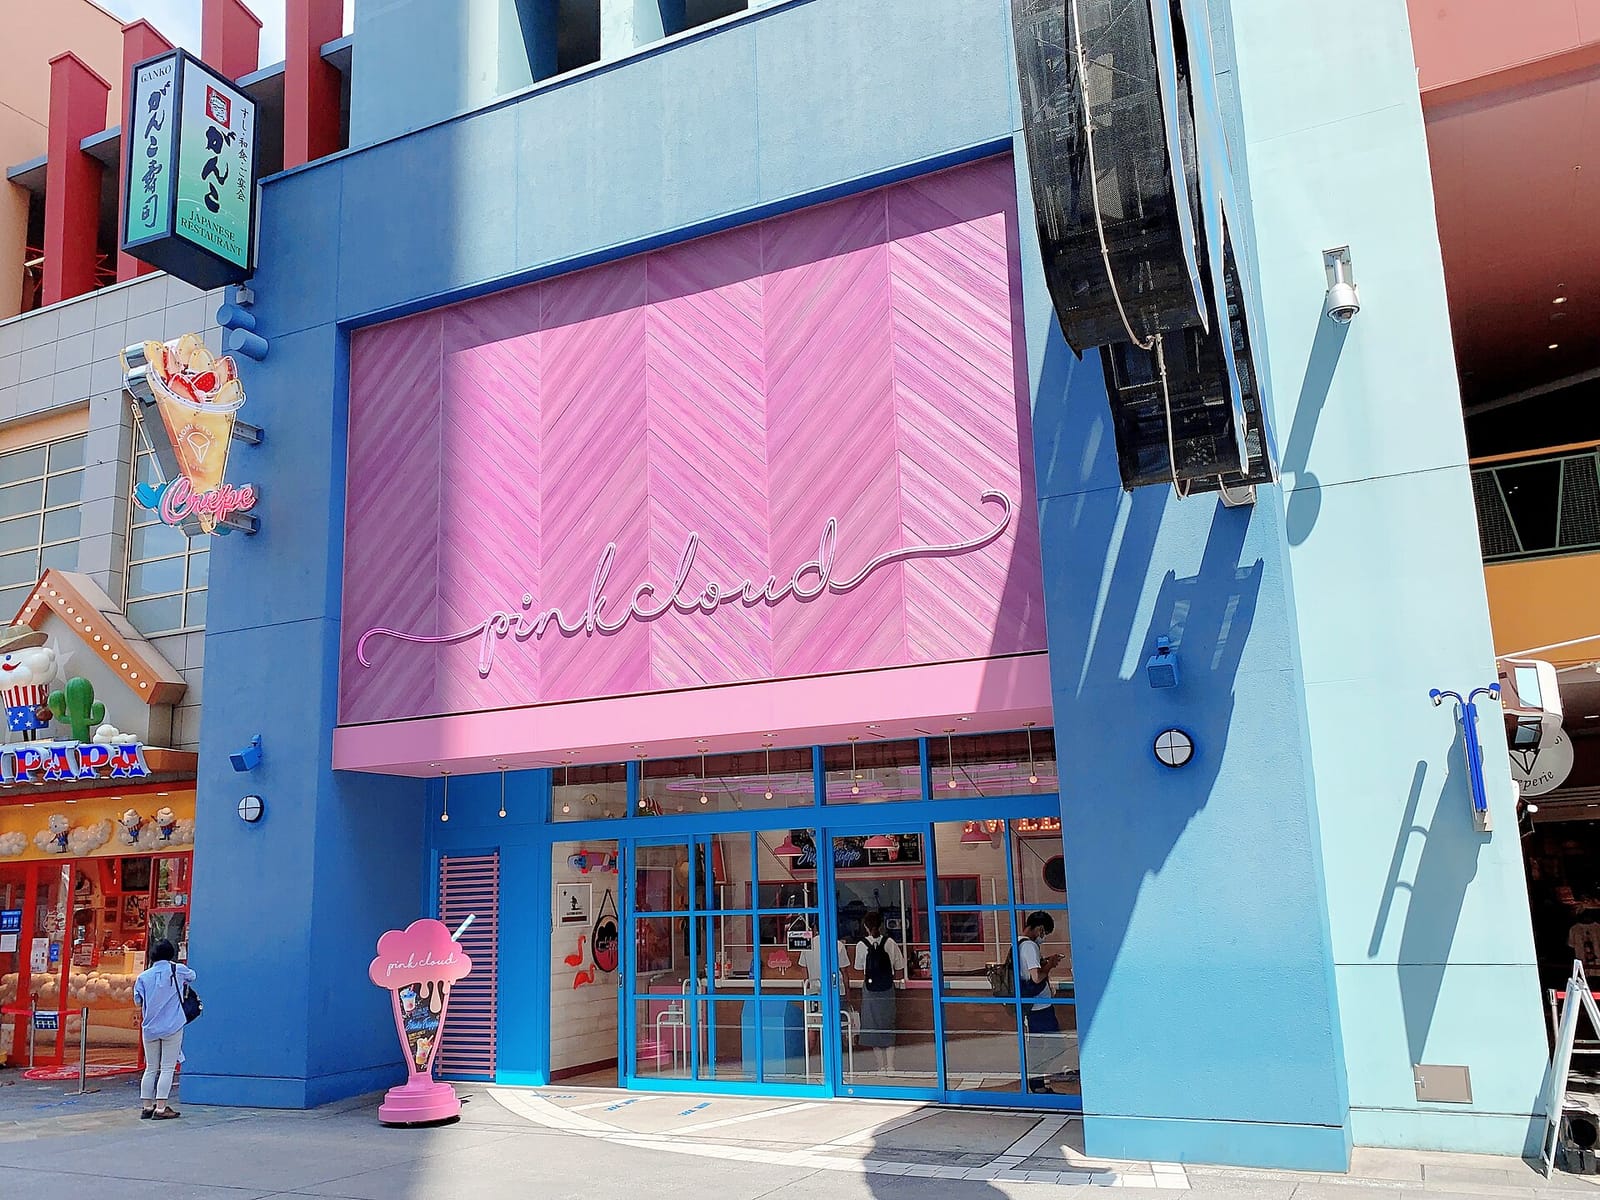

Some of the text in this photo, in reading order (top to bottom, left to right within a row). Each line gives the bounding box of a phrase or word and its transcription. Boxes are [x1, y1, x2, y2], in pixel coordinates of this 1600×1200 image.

[140, 64, 172, 83] GANKO
[201, 125, 237, 214] がんこ
[180, 217, 243, 256] RESTAURANT
[189, 210, 236, 242] JAPANESE
[161, 475, 256, 523] Crepe
[386, 951, 458, 977] pink cloud
